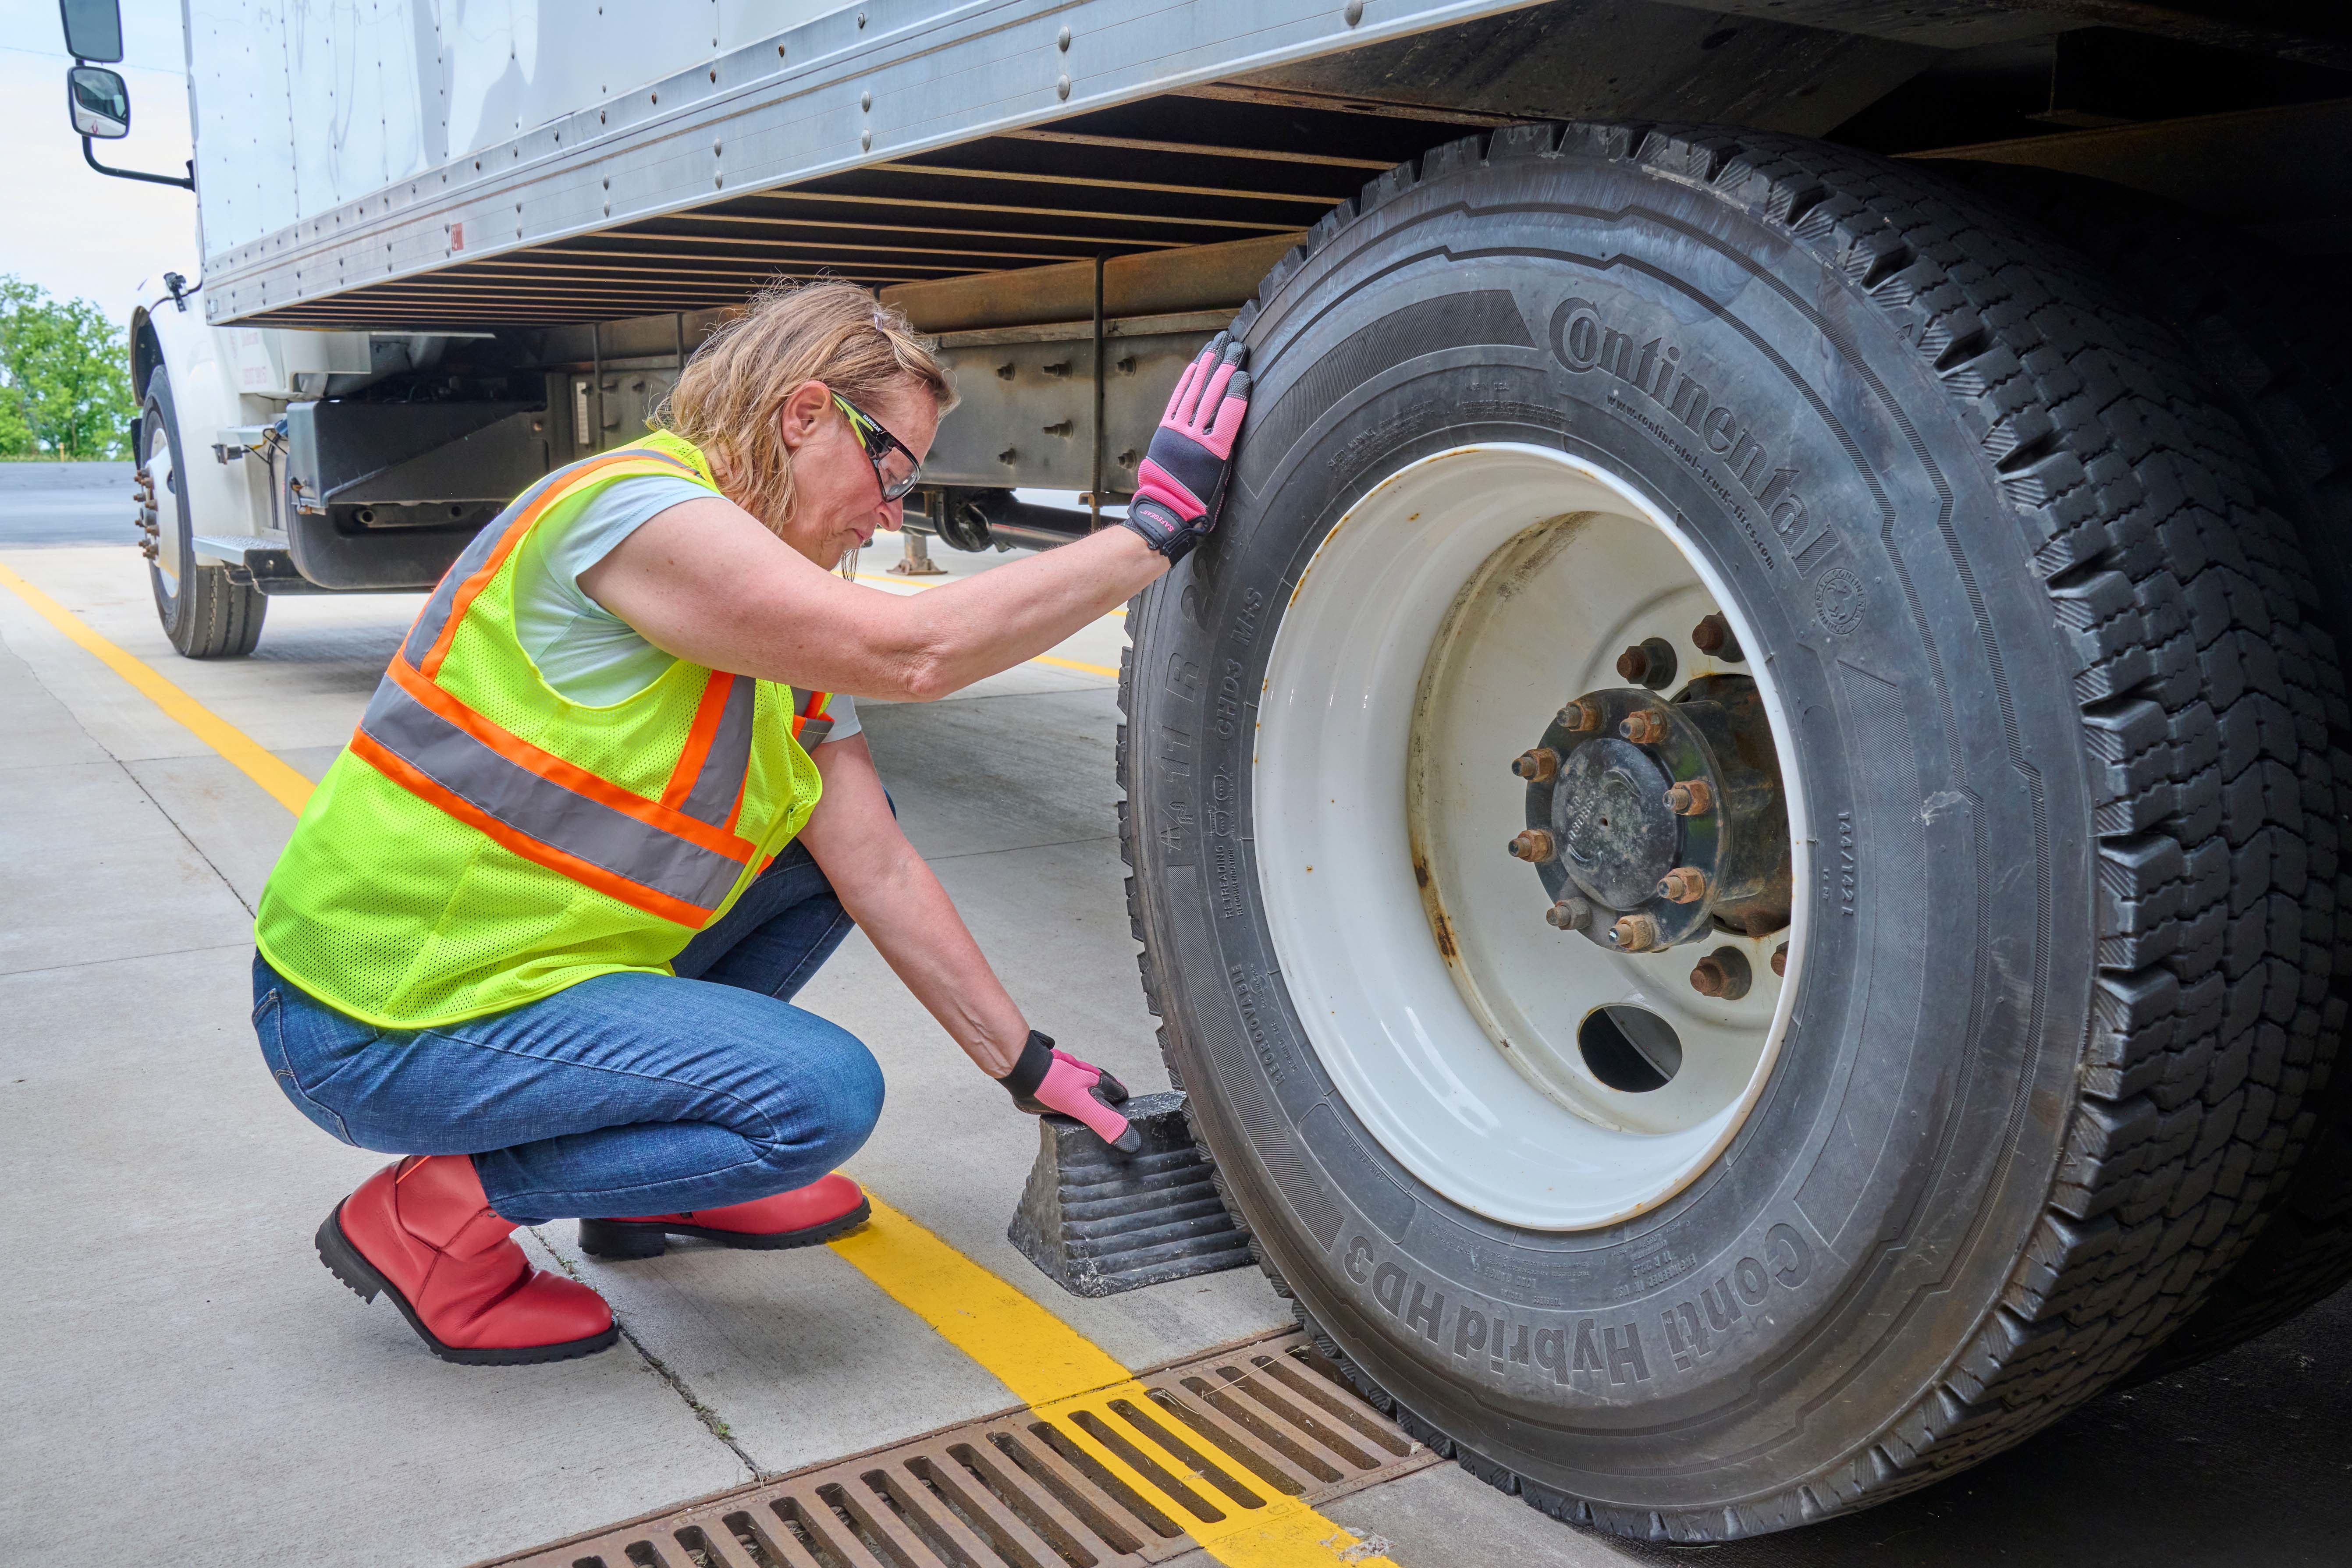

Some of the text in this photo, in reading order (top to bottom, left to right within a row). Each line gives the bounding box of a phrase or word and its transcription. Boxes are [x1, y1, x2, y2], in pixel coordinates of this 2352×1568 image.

[1549, 297, 1841, 578] Continental
[1607, 394, 1775, 570] www.continental-truck-tires.com
[1231, 588, 1263, 646] M+S
[1165, 653, 1199, 702] R
[1160, 725, 1190, 782] 11
[1215, 845, 1234, 919] RETREADING
[1230, 964, 1285, 1086] REGROOVABLE
[1271, 1020, 1298, 1073] DESIGNED FOR
[1343, 1236, 1446, 1346] HD3
[1659, 1223, 1812, 1373] Conti
[1453, 1304, 1651, 1386] Hybrid
